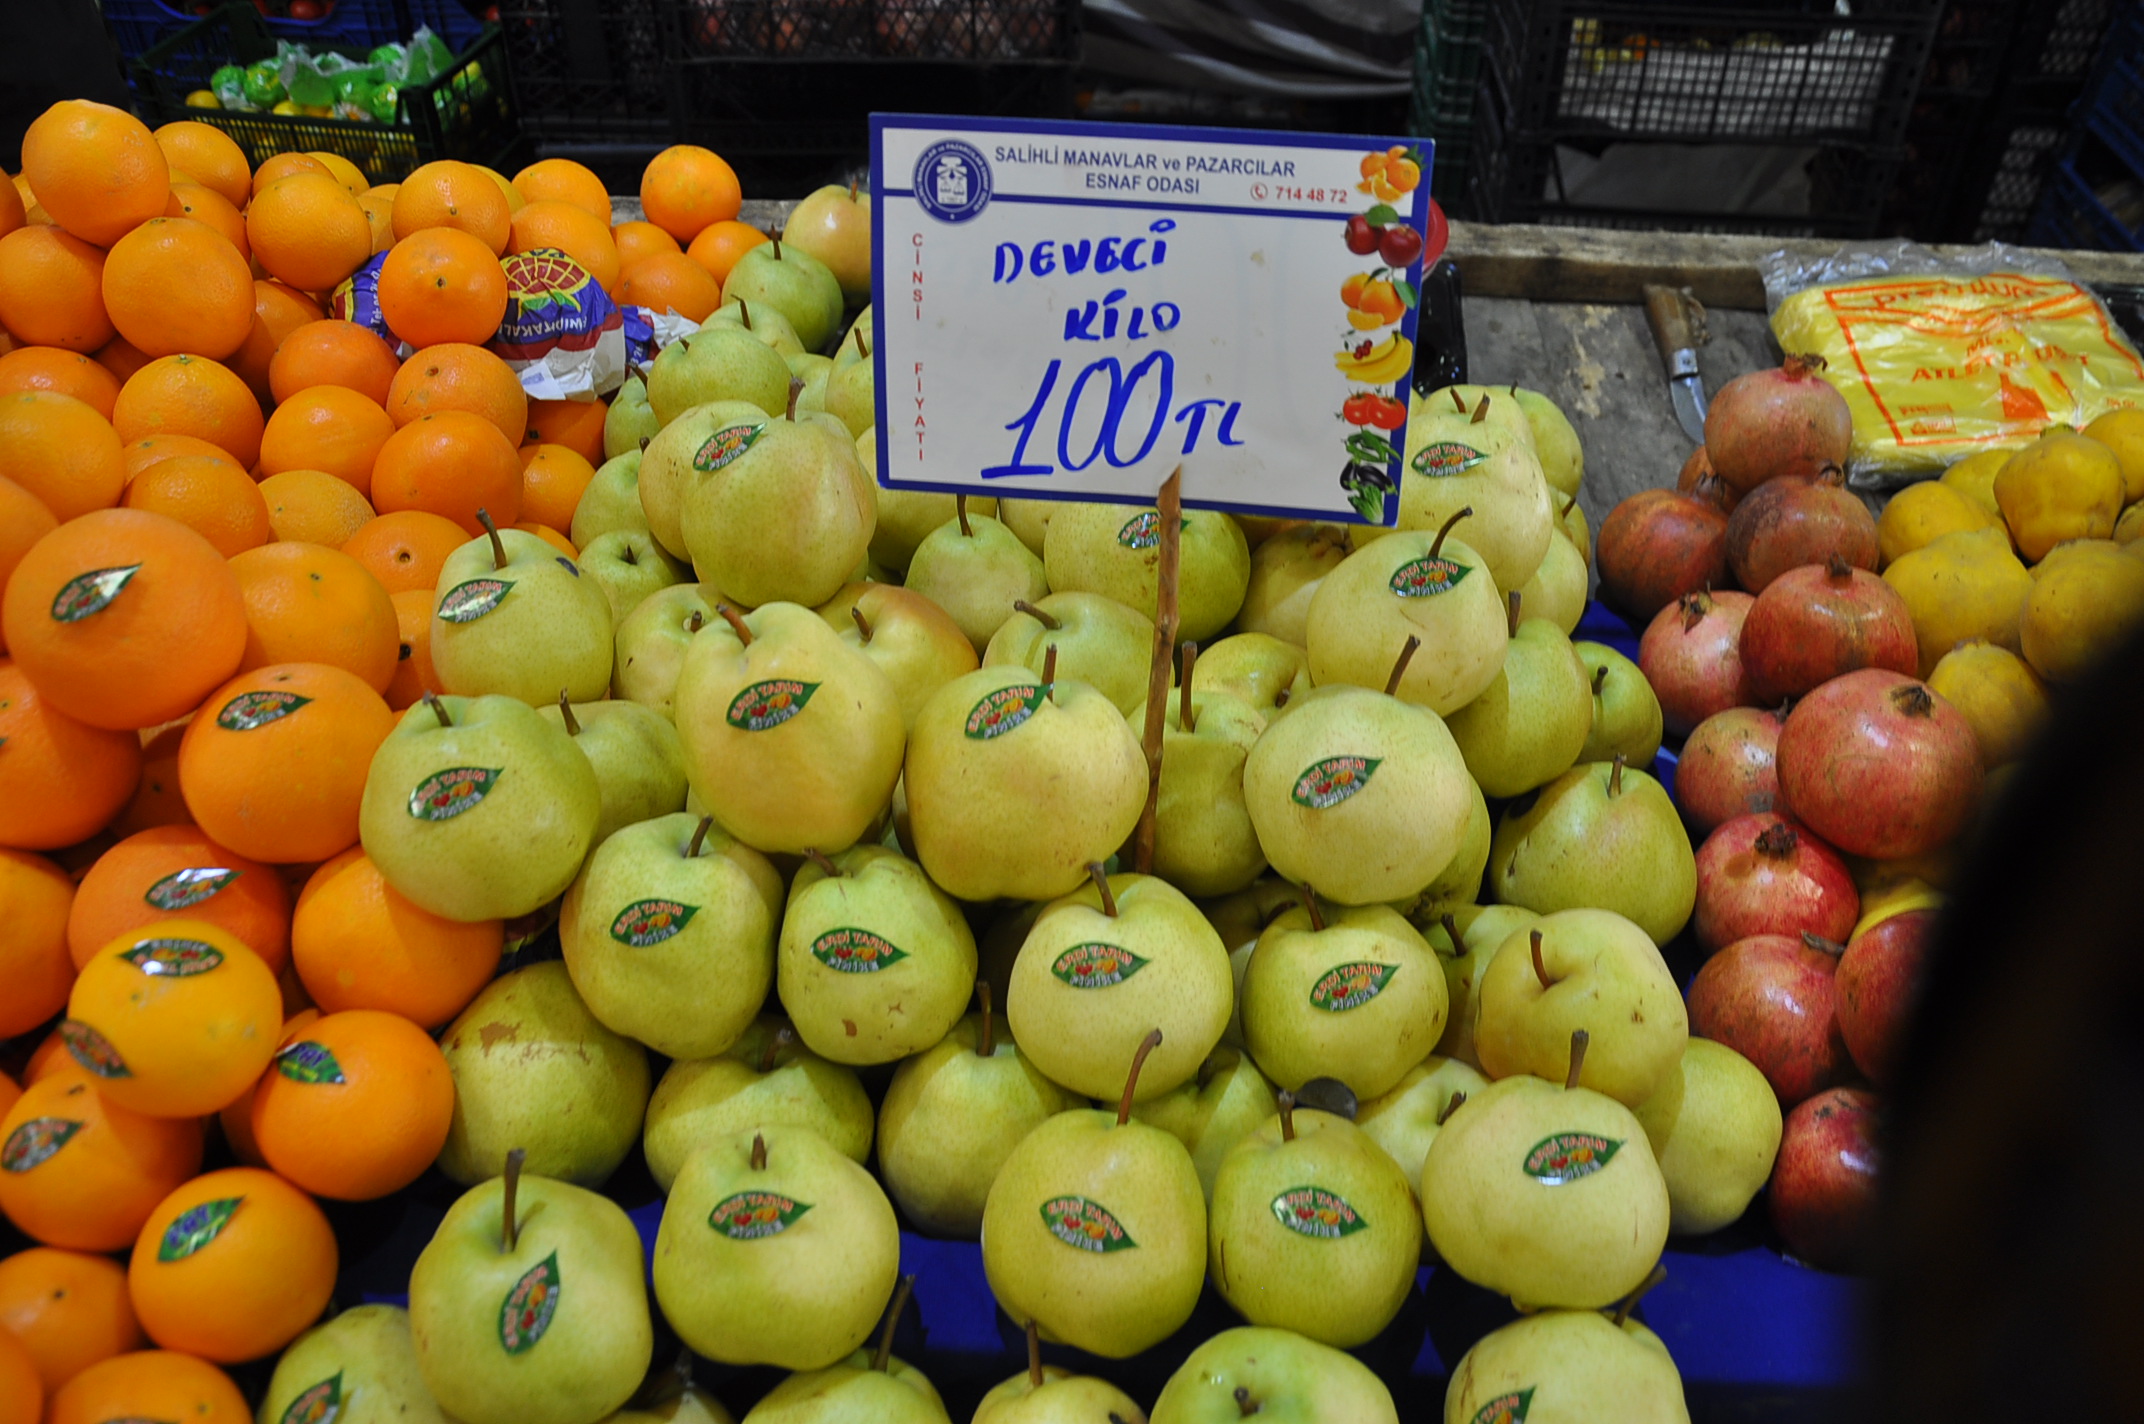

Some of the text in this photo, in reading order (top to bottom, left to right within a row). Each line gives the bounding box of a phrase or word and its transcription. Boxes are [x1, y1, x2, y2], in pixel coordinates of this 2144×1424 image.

[995, 144, 1295, 177] SALİHLİ MANAVLAR ve PAZARCILAR
[1085, 172, 1200, 194] ESNAF ODASI
[1275, 186, 1348, 203] 714 48 72
